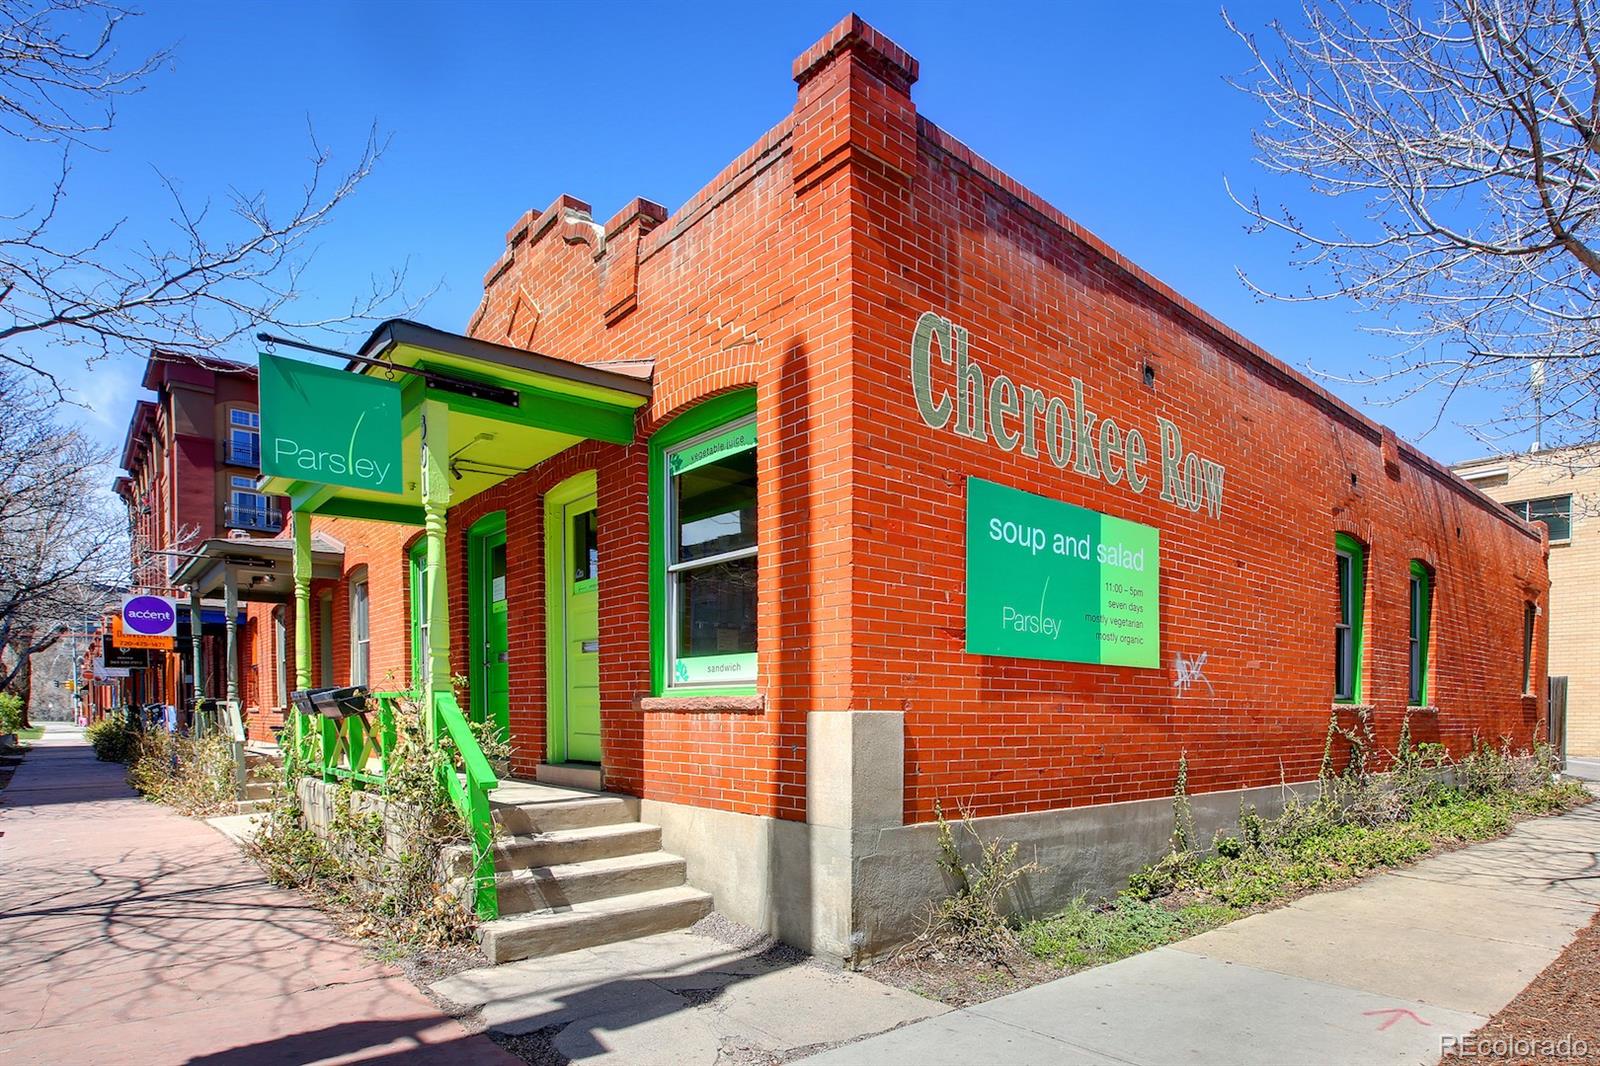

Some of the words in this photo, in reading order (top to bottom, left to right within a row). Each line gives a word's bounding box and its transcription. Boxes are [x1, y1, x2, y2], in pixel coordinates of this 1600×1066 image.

[911, 311, 1147, 493] Cherokee
[1156, 416, 1225, 520] Row
[274, 410, 391, 485] Parsley
[691, 443, 725, 461] vegetable
[726, 435, 745, 450] juice
[989, 517, 1046, 555] soup
[1052, 533, 1091, 560] and
[1096, 543, 1144, 571] salad
[1105, 582, 1123, 594] 11:00
[1129, 586, 1144, 598] 5pm
[1002, 576, 1062, 640] Parsley
[1108, 600, 1127, 610] seven
[1129, 603, 1144, 614] days
[1085, 614, 1109, 626] mostly
[1109, 617, 1144, 629] vegetarian
[1096, 632, 1118, 644] mostly
[1120, 635, 1144, 646] organic
[707, 663, 742, 673] sandwich
